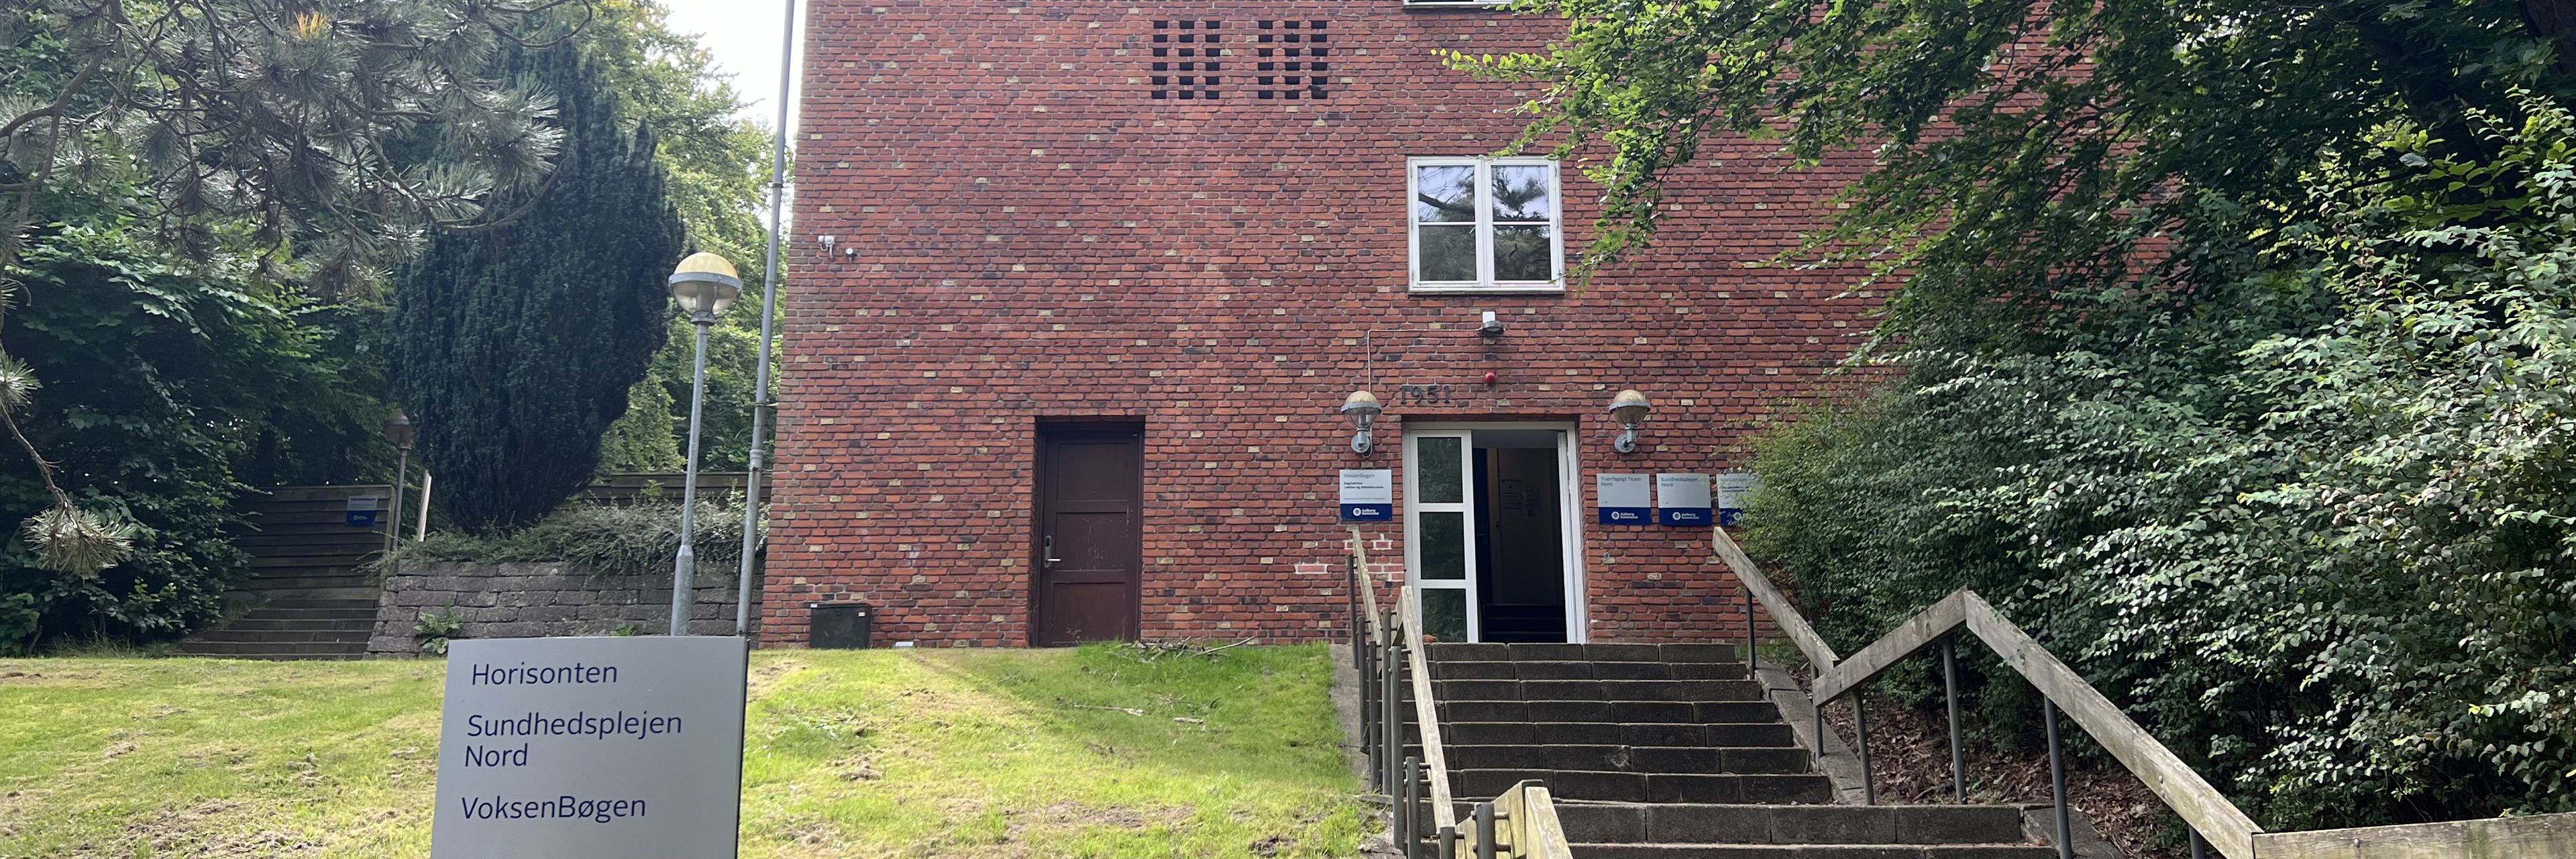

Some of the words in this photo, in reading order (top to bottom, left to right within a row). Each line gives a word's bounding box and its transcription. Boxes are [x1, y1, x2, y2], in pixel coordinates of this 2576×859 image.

[1401, 385, 1450, 403] 1951
[472, 662, 619, 685] Horisonten
[468, 711, 682, 740] Sundhedsplejen
[465, 743, 528, 767] Nord
[462, 795, 647, 823] VoksenBøgen
